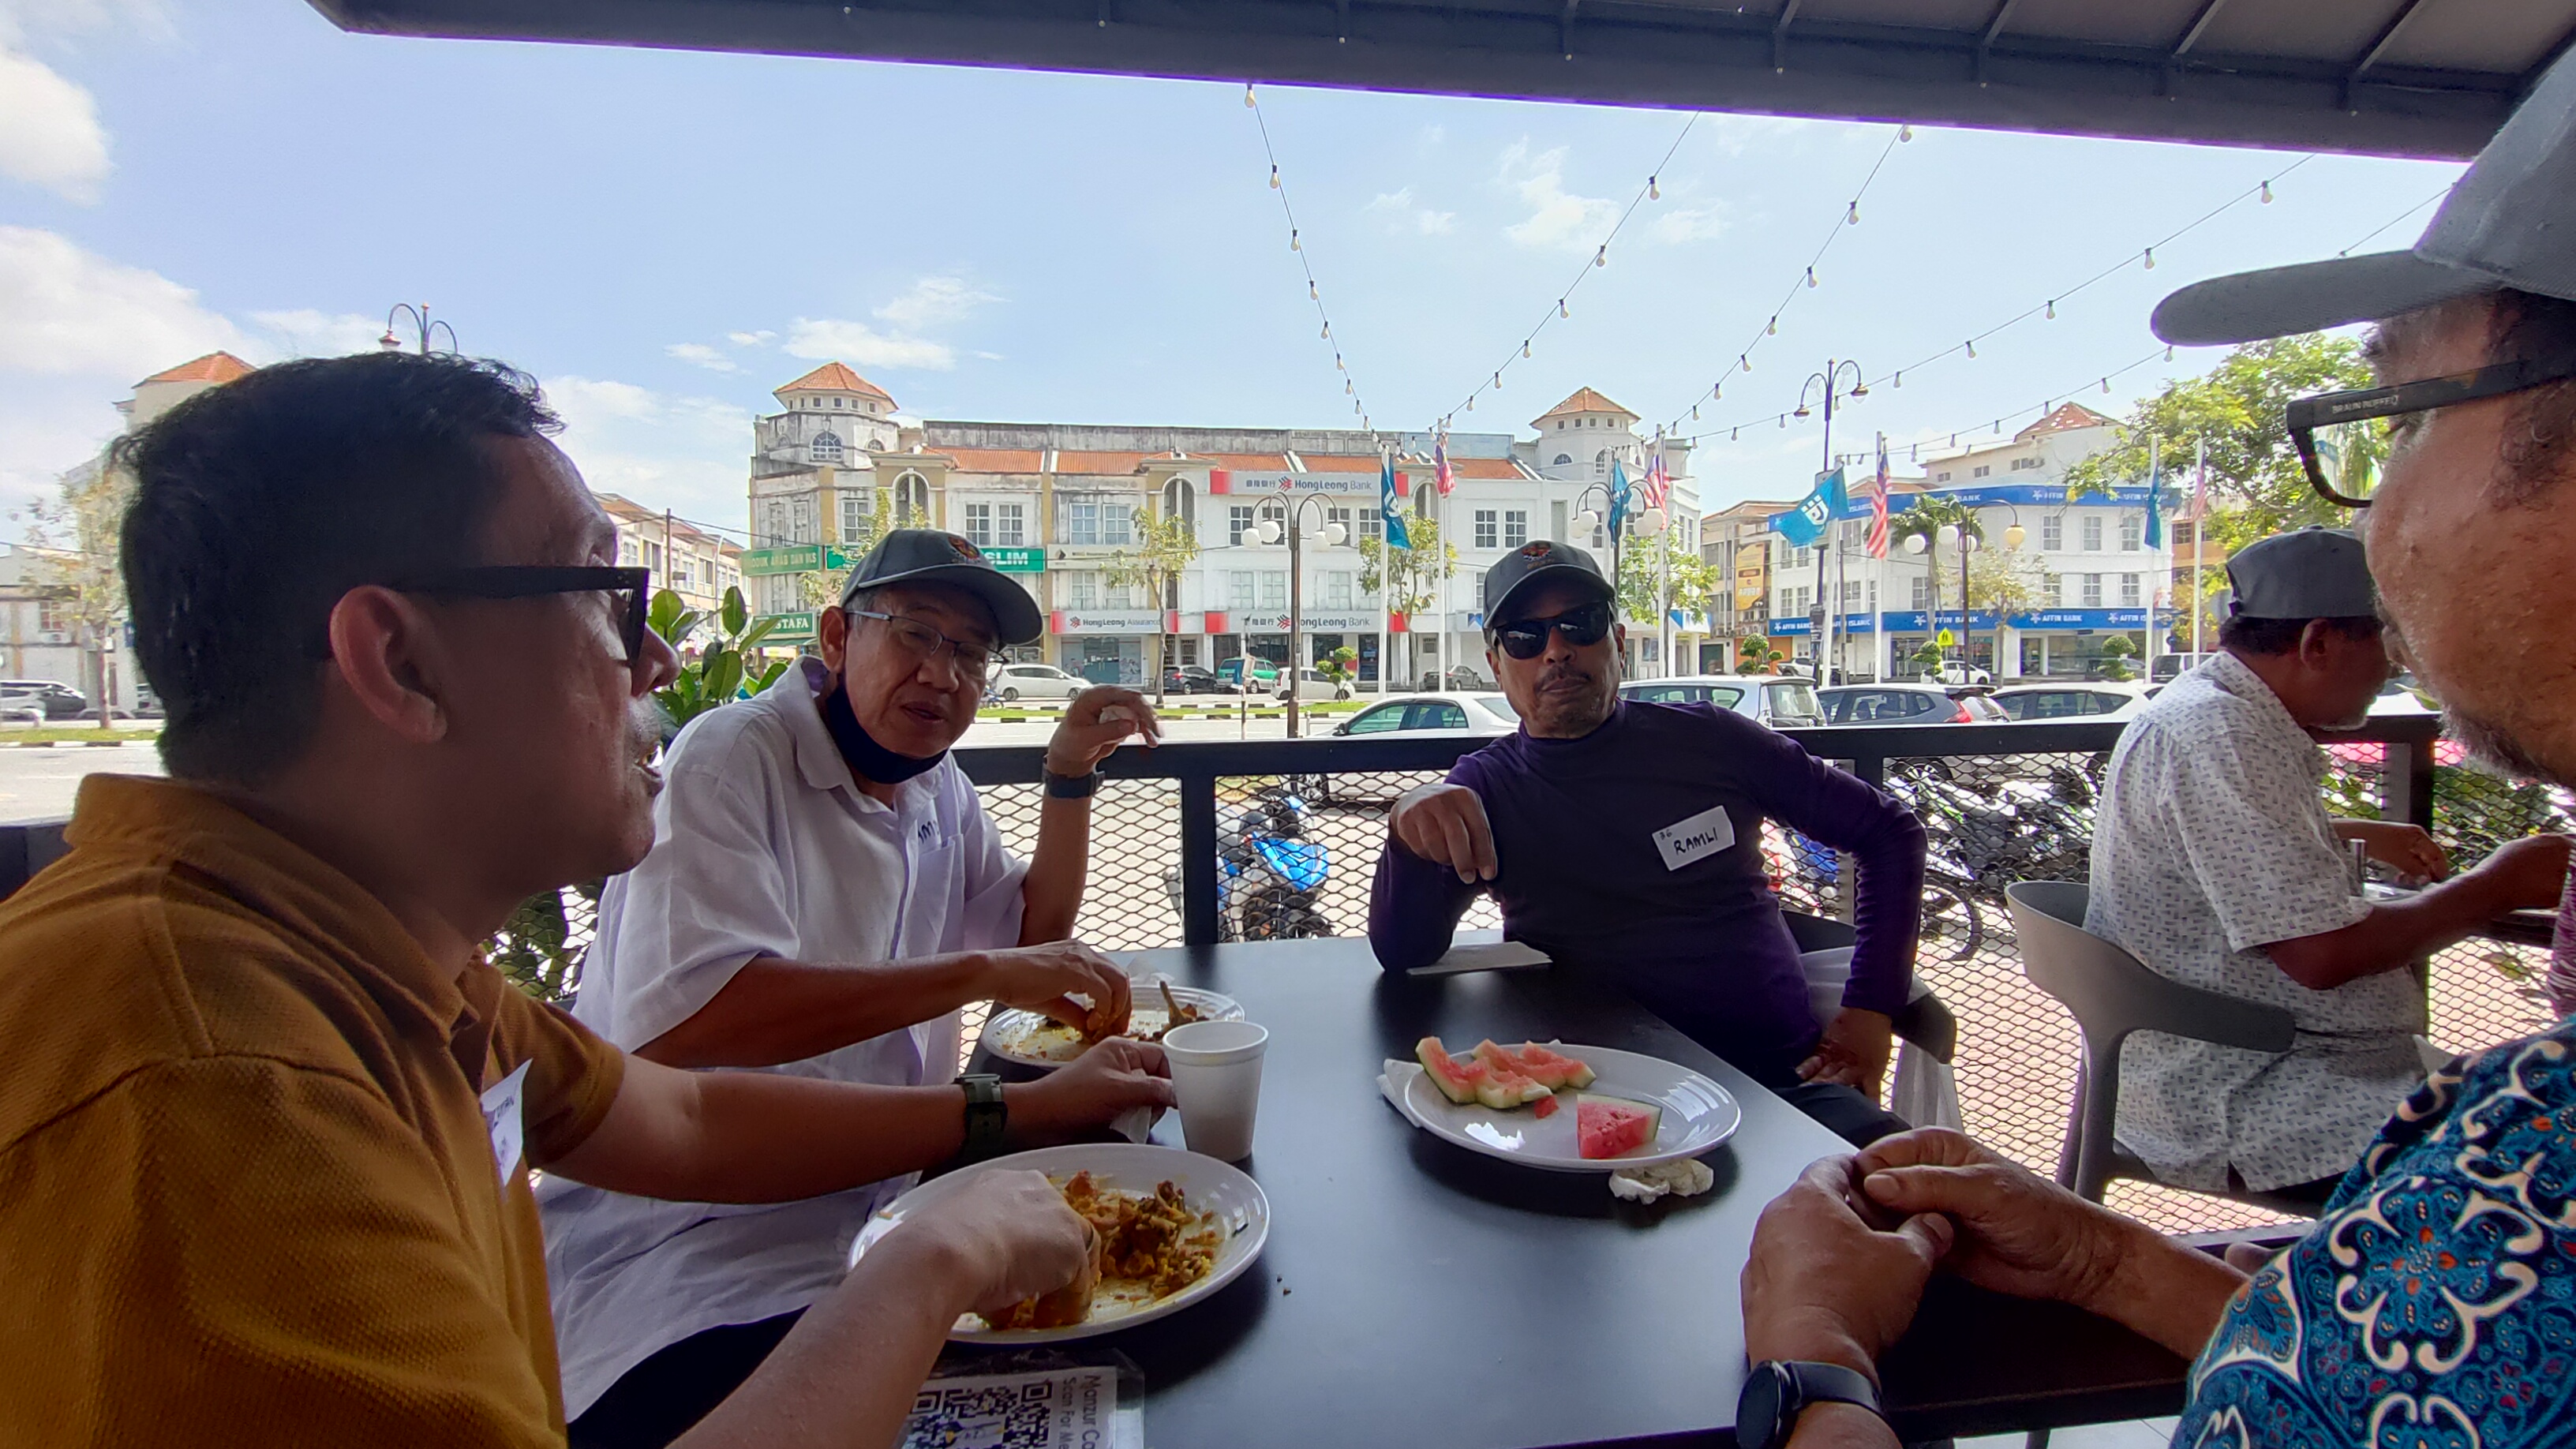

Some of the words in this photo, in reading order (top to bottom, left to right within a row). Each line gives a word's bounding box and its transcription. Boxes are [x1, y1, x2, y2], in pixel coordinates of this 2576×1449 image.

[1350, 480, 1372, 490] Bank
[1300, 617, 1347, 628] ongLeong
[1348, 617, 1370, 626] Bank
[1673, 826, 1718, 856] RAMLI
[1061, 1376, 1077, 1407] Scan
[1082, 1375, 1102, 1425] Manzur
[1060, 1410, 1075, 1428] For
